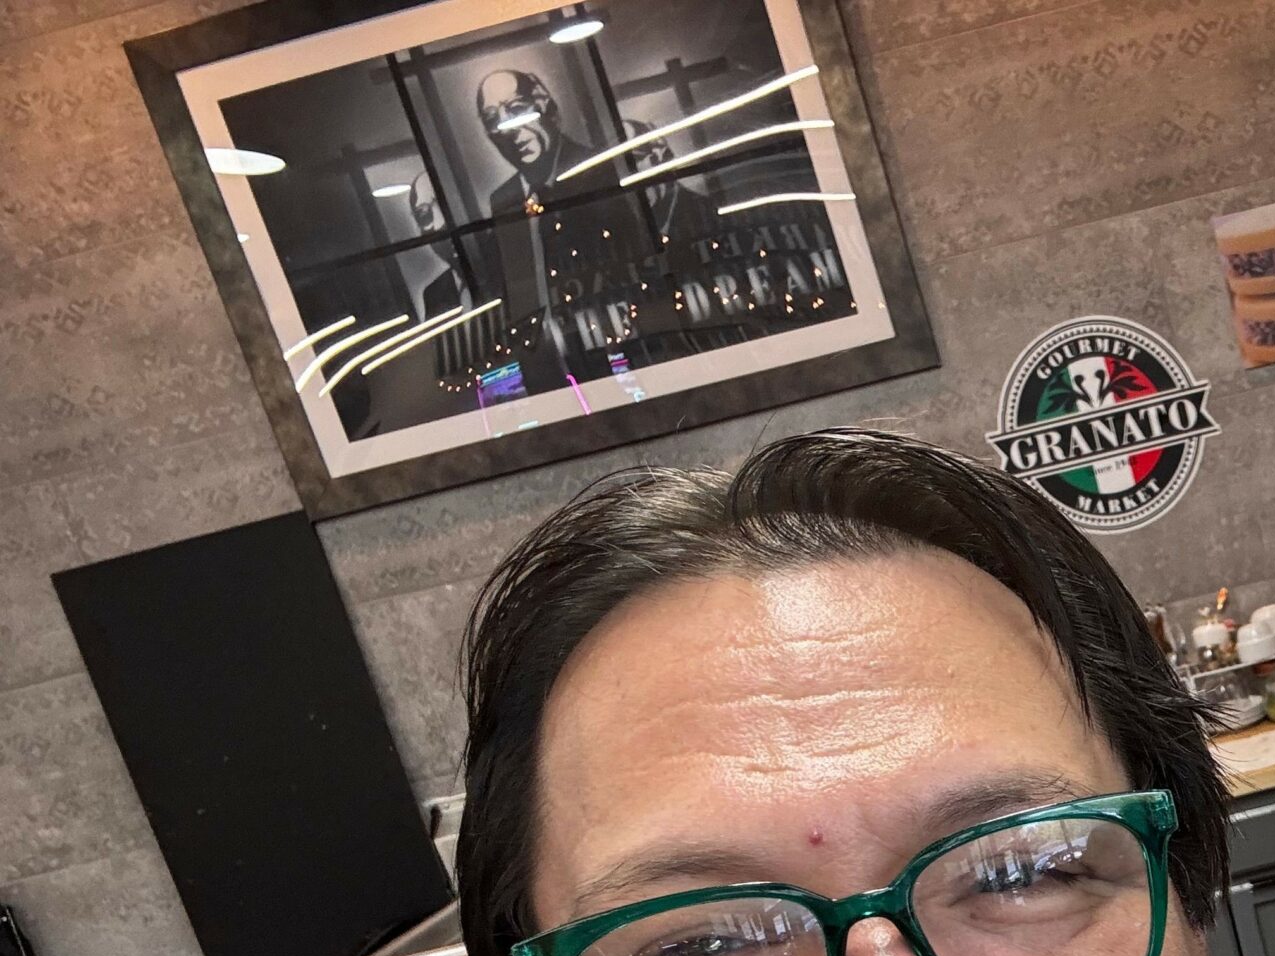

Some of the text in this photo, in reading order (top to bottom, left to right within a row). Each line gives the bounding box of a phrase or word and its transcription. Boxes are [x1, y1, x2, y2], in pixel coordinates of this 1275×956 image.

[681, 247, 845, 323] DREAM
[1036, 337, 1141, 380] GOURMET
[1009, 399, 1198, 470] GRANATO
[1076, 478, 1161, 514] MARKET
